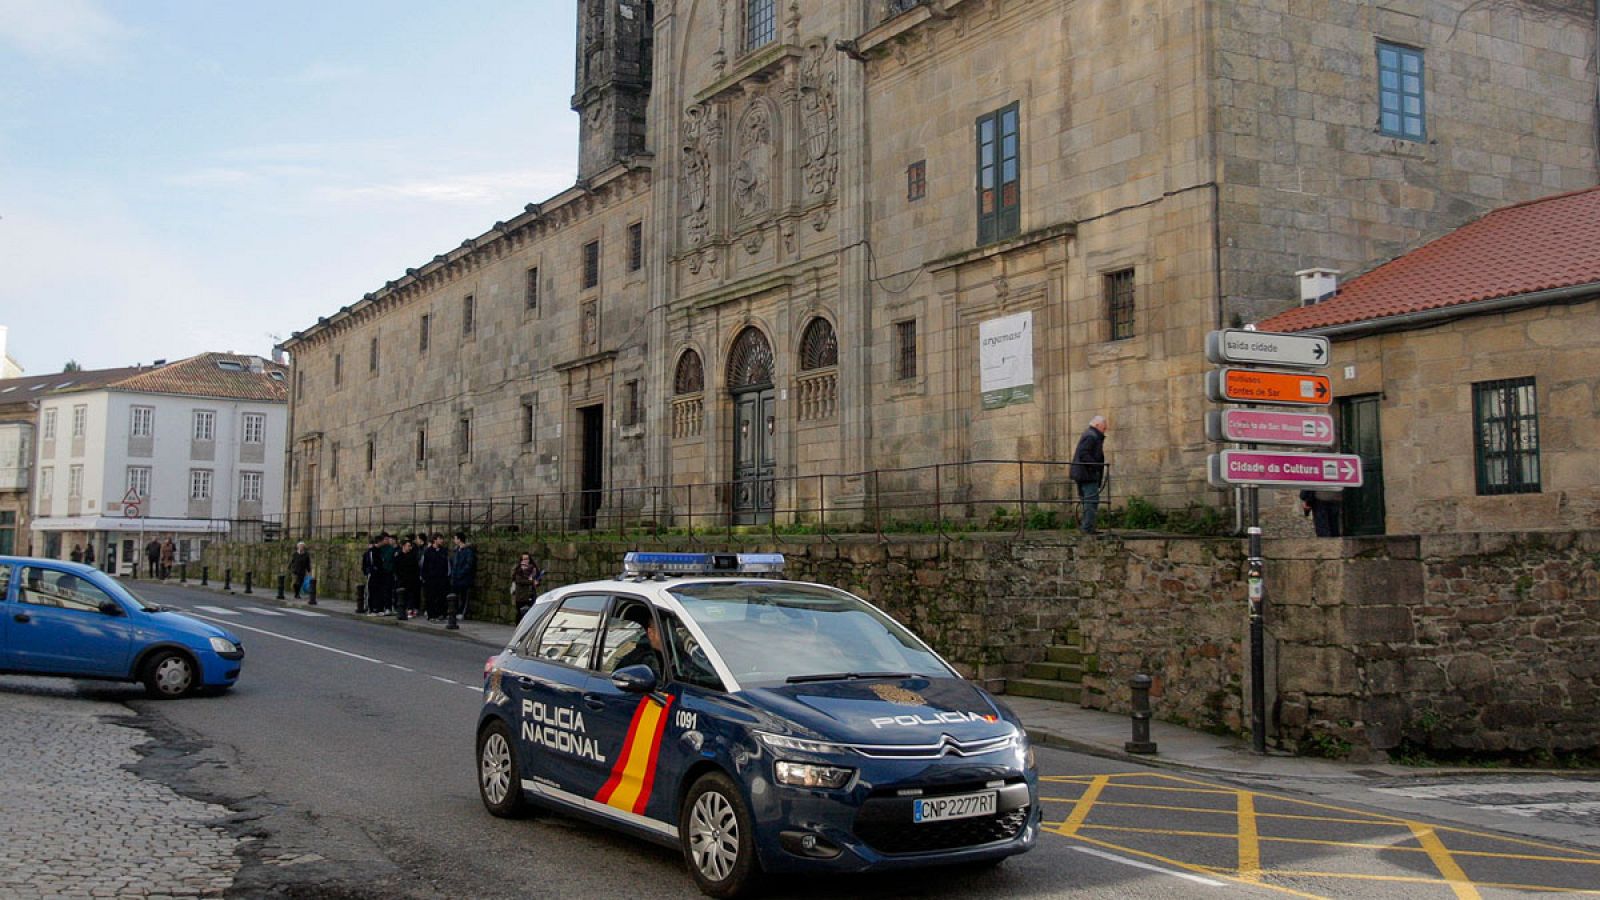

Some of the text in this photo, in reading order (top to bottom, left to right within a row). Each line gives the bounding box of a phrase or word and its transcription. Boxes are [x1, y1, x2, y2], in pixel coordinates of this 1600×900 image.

[1251, 343, 1278, 353] cidade
[1228, 386, 1280, 397] Fontes de Sar
[1230, 461, 1319, 475] Cidade da Cultura
[522, 698, 586, 733] POLICÍA
[522, 720, 606, 762] NACIONAL
